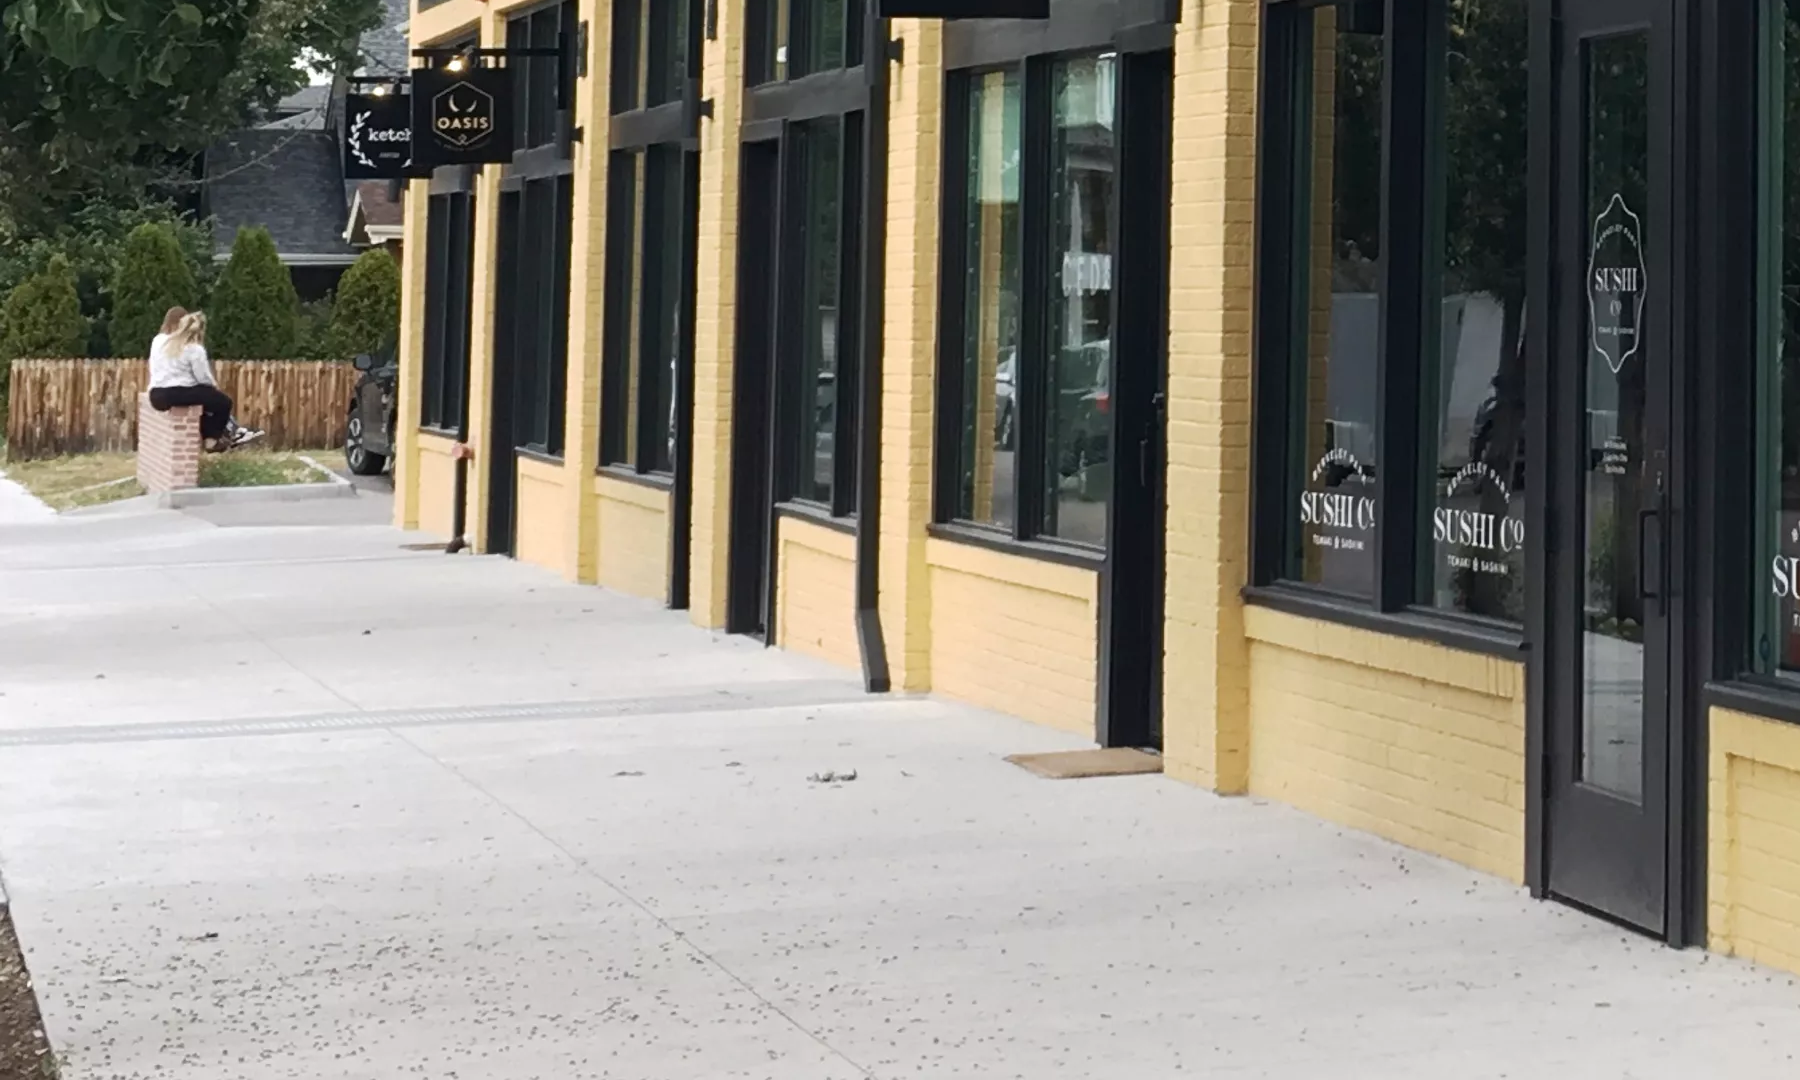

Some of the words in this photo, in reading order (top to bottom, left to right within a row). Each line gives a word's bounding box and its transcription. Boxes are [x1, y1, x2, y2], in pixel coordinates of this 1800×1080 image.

[437, 117, 489, 129] OASIS
[1595, 267, 1638, 292] SUSHI
[1300, 490, 1355, 529] SUSHI
[1433, 506, 1496, 550] SUSHI
